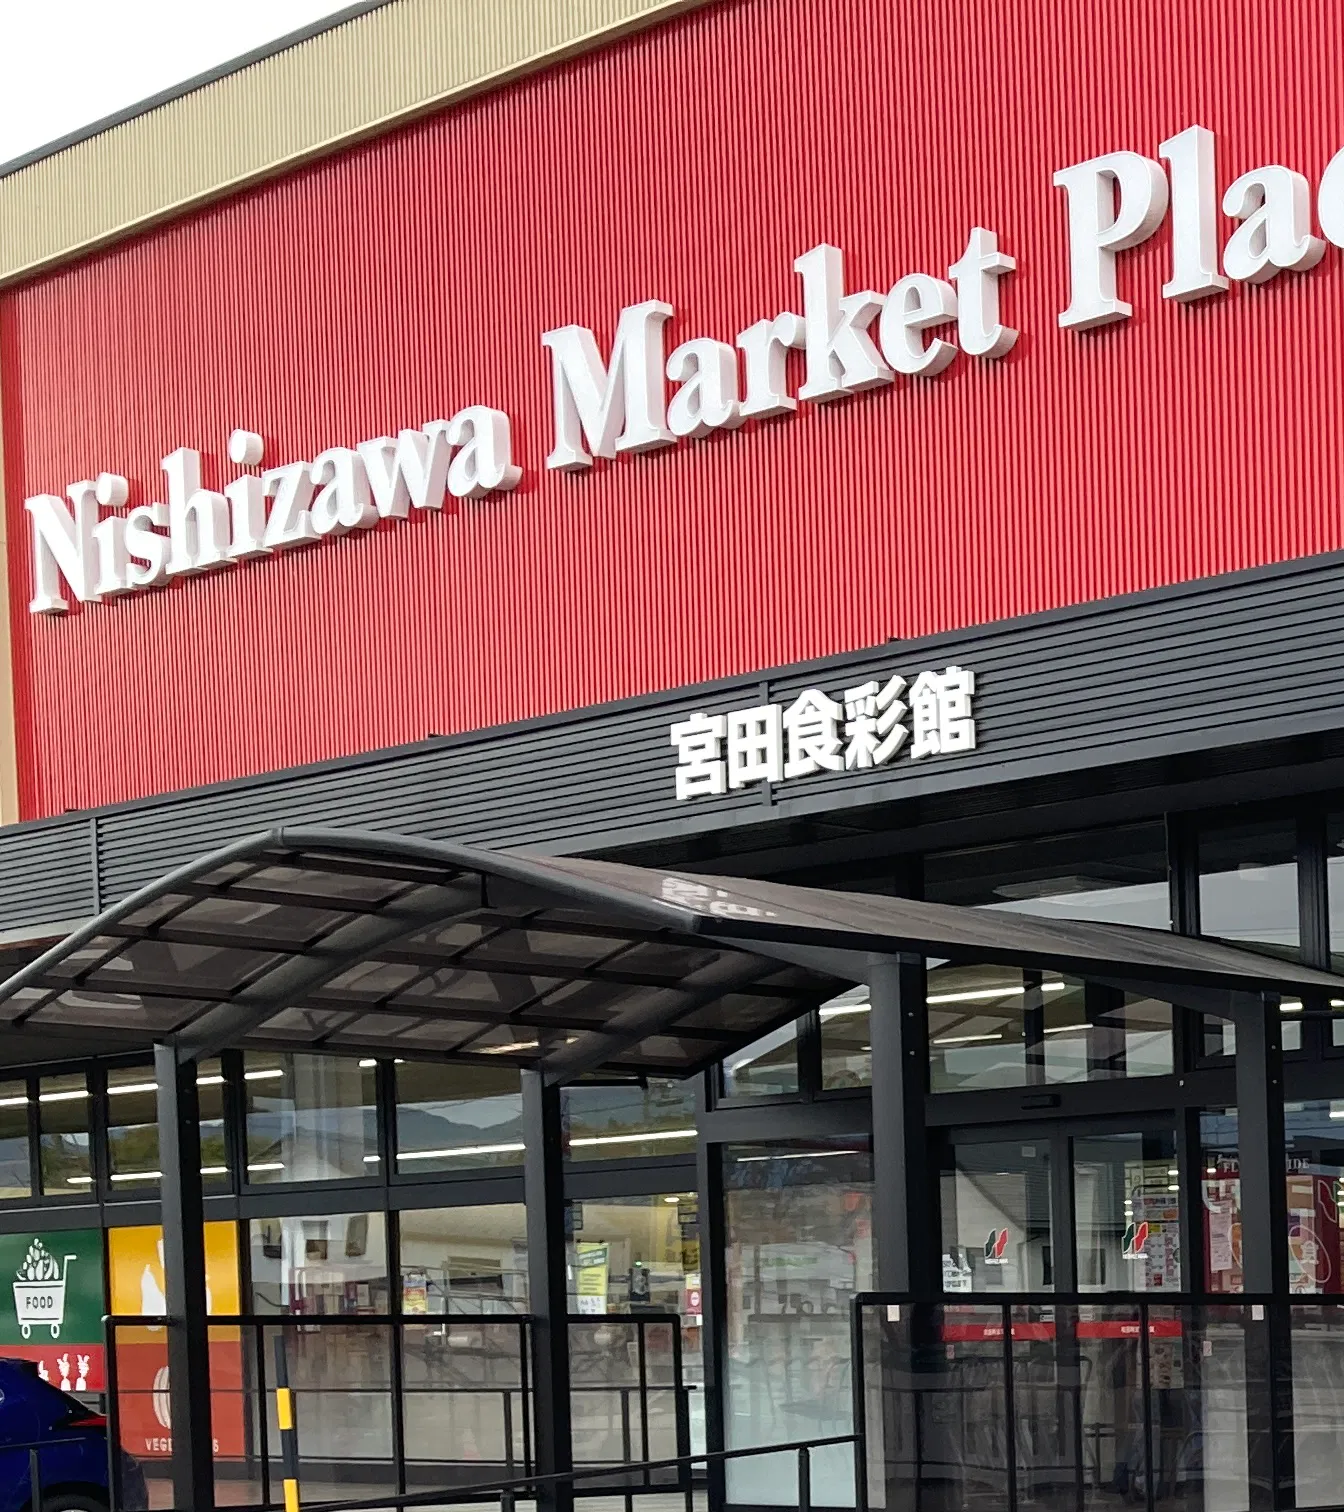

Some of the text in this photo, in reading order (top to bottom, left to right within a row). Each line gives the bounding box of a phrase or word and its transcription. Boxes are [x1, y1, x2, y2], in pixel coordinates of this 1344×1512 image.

[24, 404, 524, 616] Nishizawa
[541, 226, 1021, 473] Market
[670, 665, 977, 800] 宮田食彩館
[25, 1295, 54, 1310] FOOD
